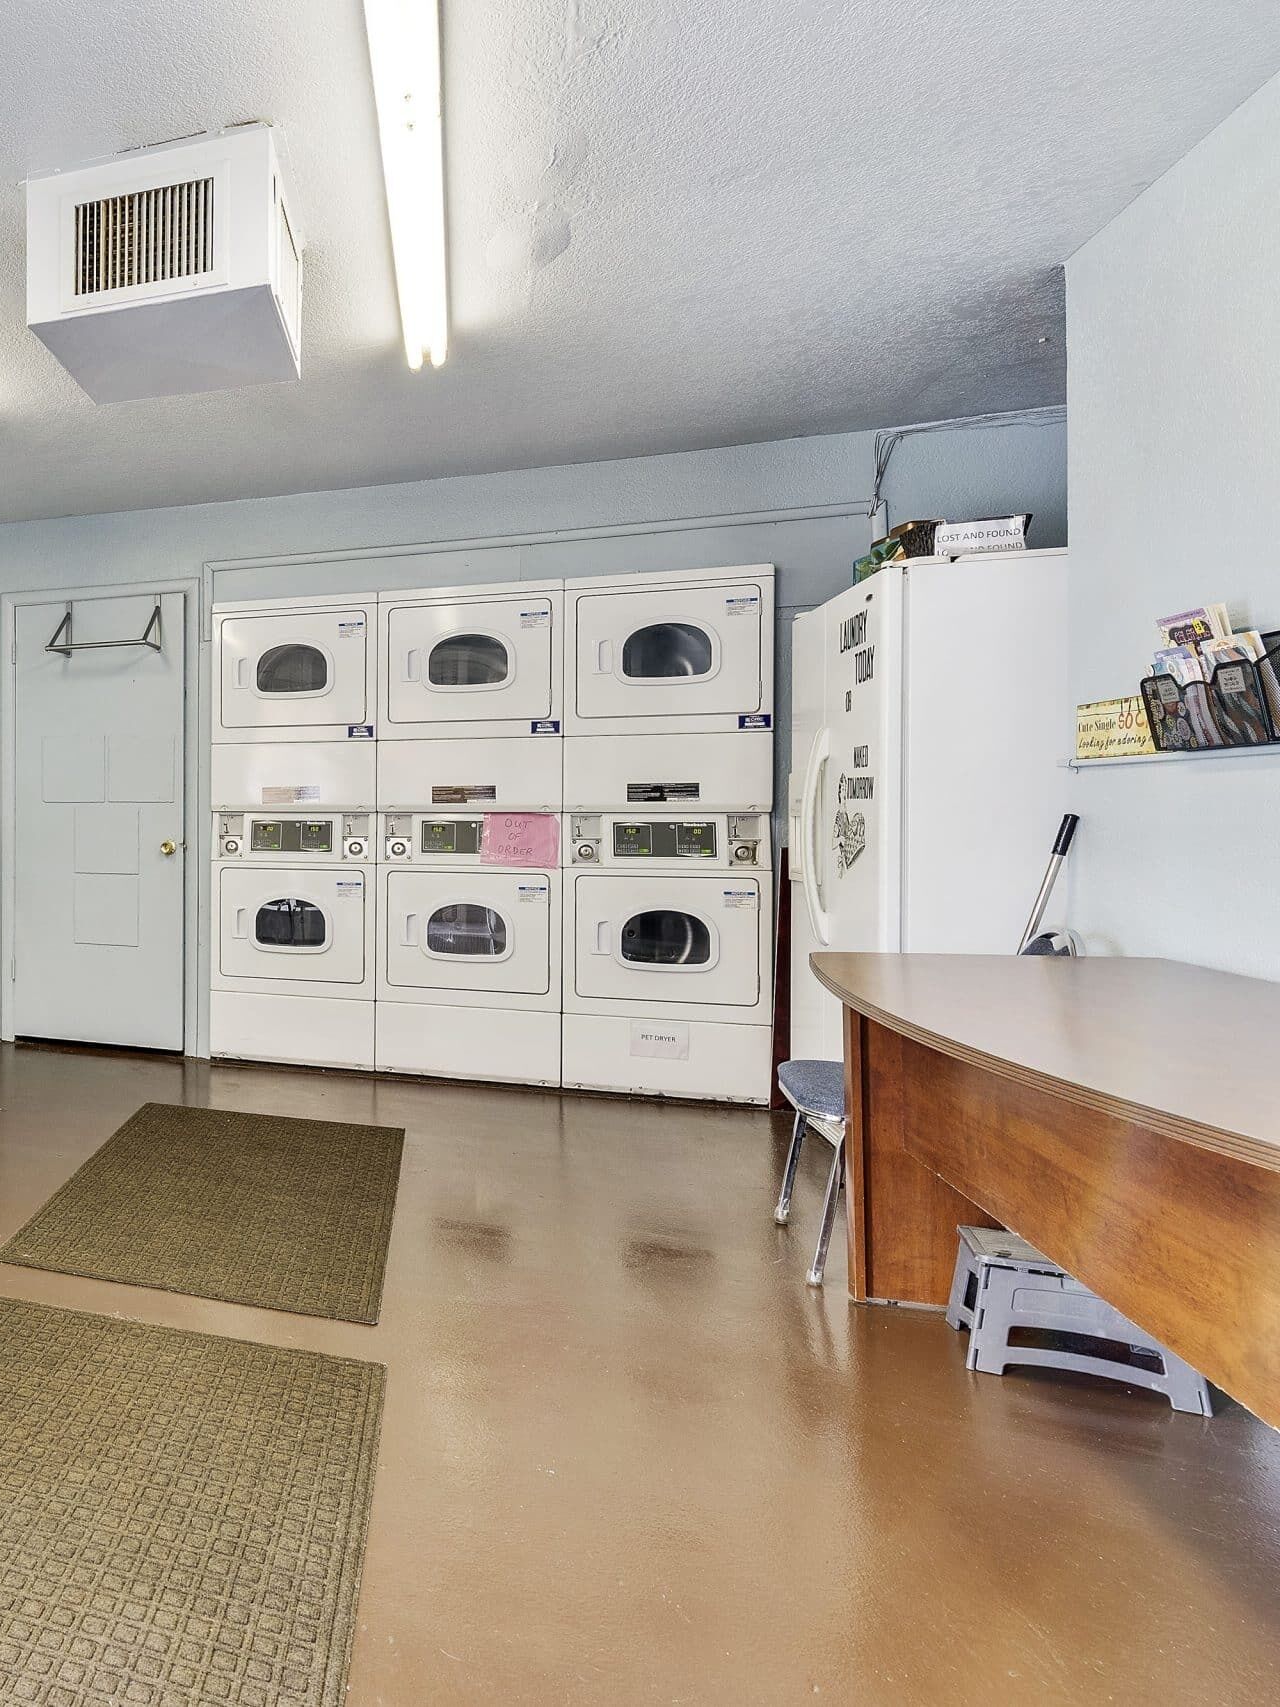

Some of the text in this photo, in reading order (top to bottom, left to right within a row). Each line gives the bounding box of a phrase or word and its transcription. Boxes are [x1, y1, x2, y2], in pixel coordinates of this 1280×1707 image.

[936, 528, 1021, 544] LOST AND FOUND
[840, 608, 868, 654] LAUNDRY
[854, 644, 874, 686] TODAY
[846, 690, 852, 712] OR
[1078, 712, 1148, 732] Cute Single SOC
[1078, 736, 1104, 750] Looking
[1104, 736, 1116, 750] for
[1117, 732, 1146, 748] adoring
[854, 744, 868, 769] NAKED
[847, 776, 874, 800] TOMORROW
[504, 818, 534, 828] OUT
[508, 832, 522, 841] OF
[498, 844, 534, 856] ORDER
[654, 1035, 676, 1043] DRYER
